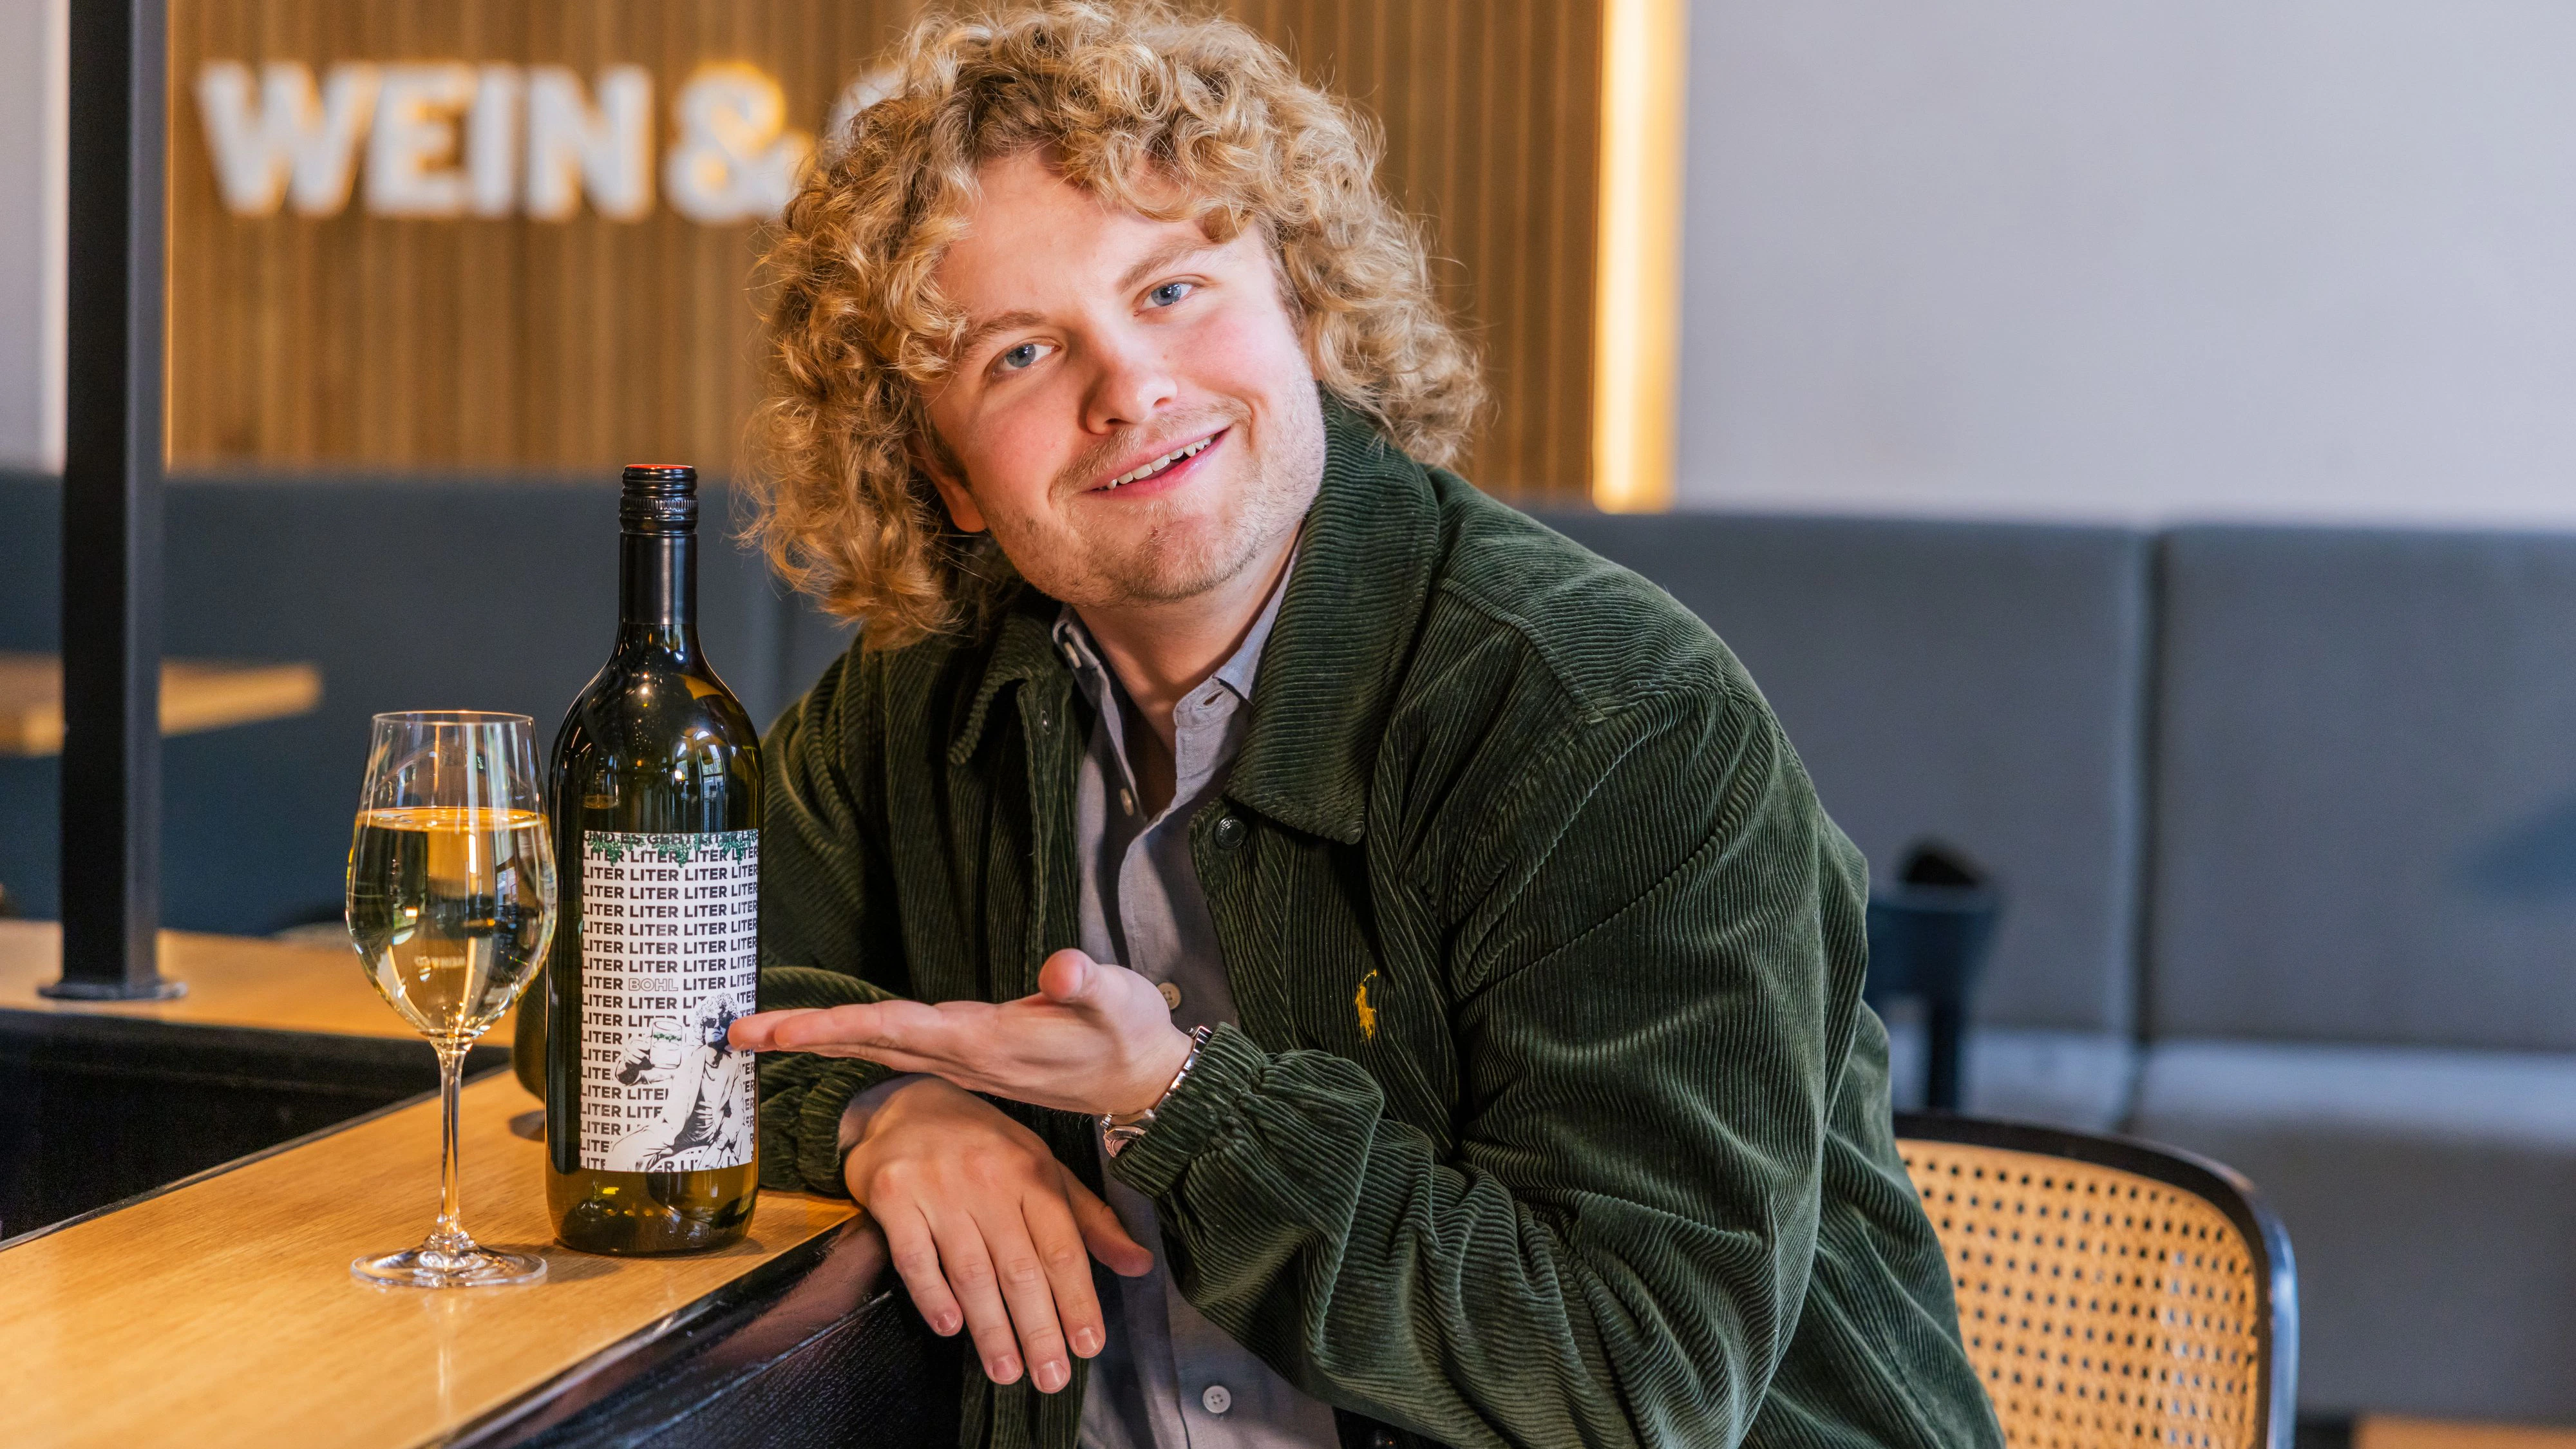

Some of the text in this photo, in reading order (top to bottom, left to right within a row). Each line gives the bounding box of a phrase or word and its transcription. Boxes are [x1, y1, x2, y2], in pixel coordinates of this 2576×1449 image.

[197, 61, 654, 220] WEIN
[667, 61, 813, 223] &
[732, 845, 758, 861] LTER
[583, 864, 757, 882] LITER LITER LITER LITER
[583, 882, 757, 900] LITER LITER LITER LITER
[582, 900, 757, 918] LITER LITER LITER LITER
[582, 918, 757, 936] LITER LITER LITER LITER
[582, 936, 757, 954] LITER LITER LITER LITER
[582, 954, 757, 973] LITER LITER LITER LITER
[582, 972, 756, 991] LITER BOHL LITER LITER
[582, 993, 623, 1009] LITER
[629, 996, 677, 1010] LITER
[582, 1011, 623, 1027] LITER
[629, 1015, 677, 1028] LIT
[582, 1030, 622, 1045] LITER
[582, 1066, 613, 1081] LITE
[582, 1084, 621, 1099] LITER
[581, 1102, 621, 1117] LITER
[581, 1121, 621, 1135] LITER
[581, 1139, 612, 1153] LITE
